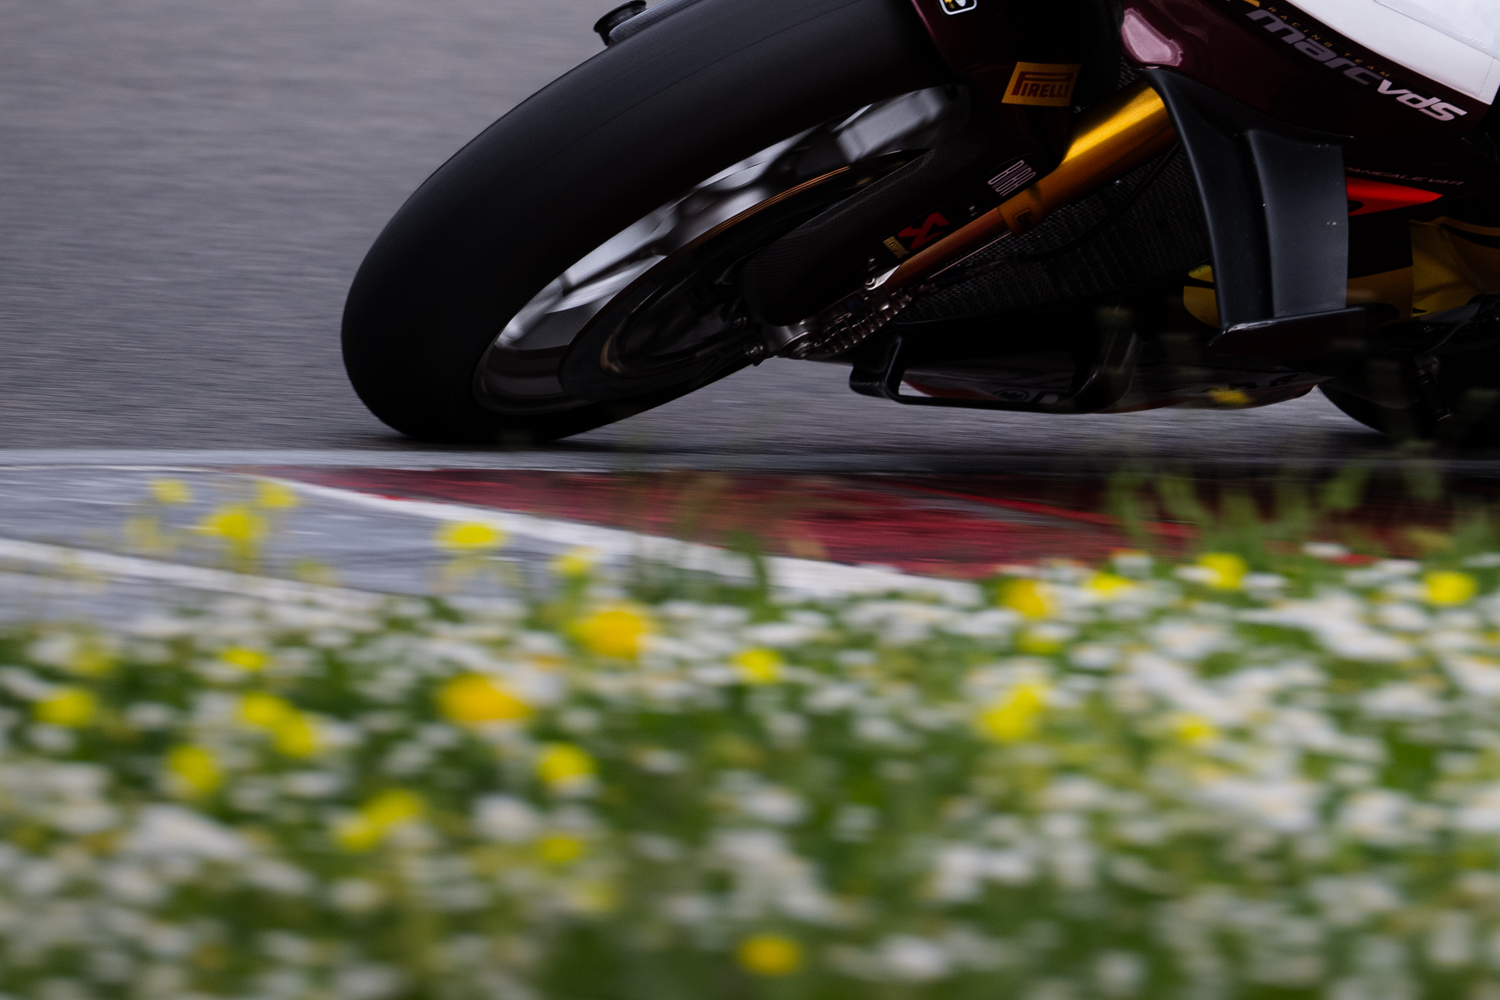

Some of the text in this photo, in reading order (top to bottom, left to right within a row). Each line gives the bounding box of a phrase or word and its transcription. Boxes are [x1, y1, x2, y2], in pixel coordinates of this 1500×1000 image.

[1245, 8, 1468, 122] marcvds
[1267, 6, 1391, 78] RACING TEAM
[1011, 71, 1075, 99] PIRELLI
